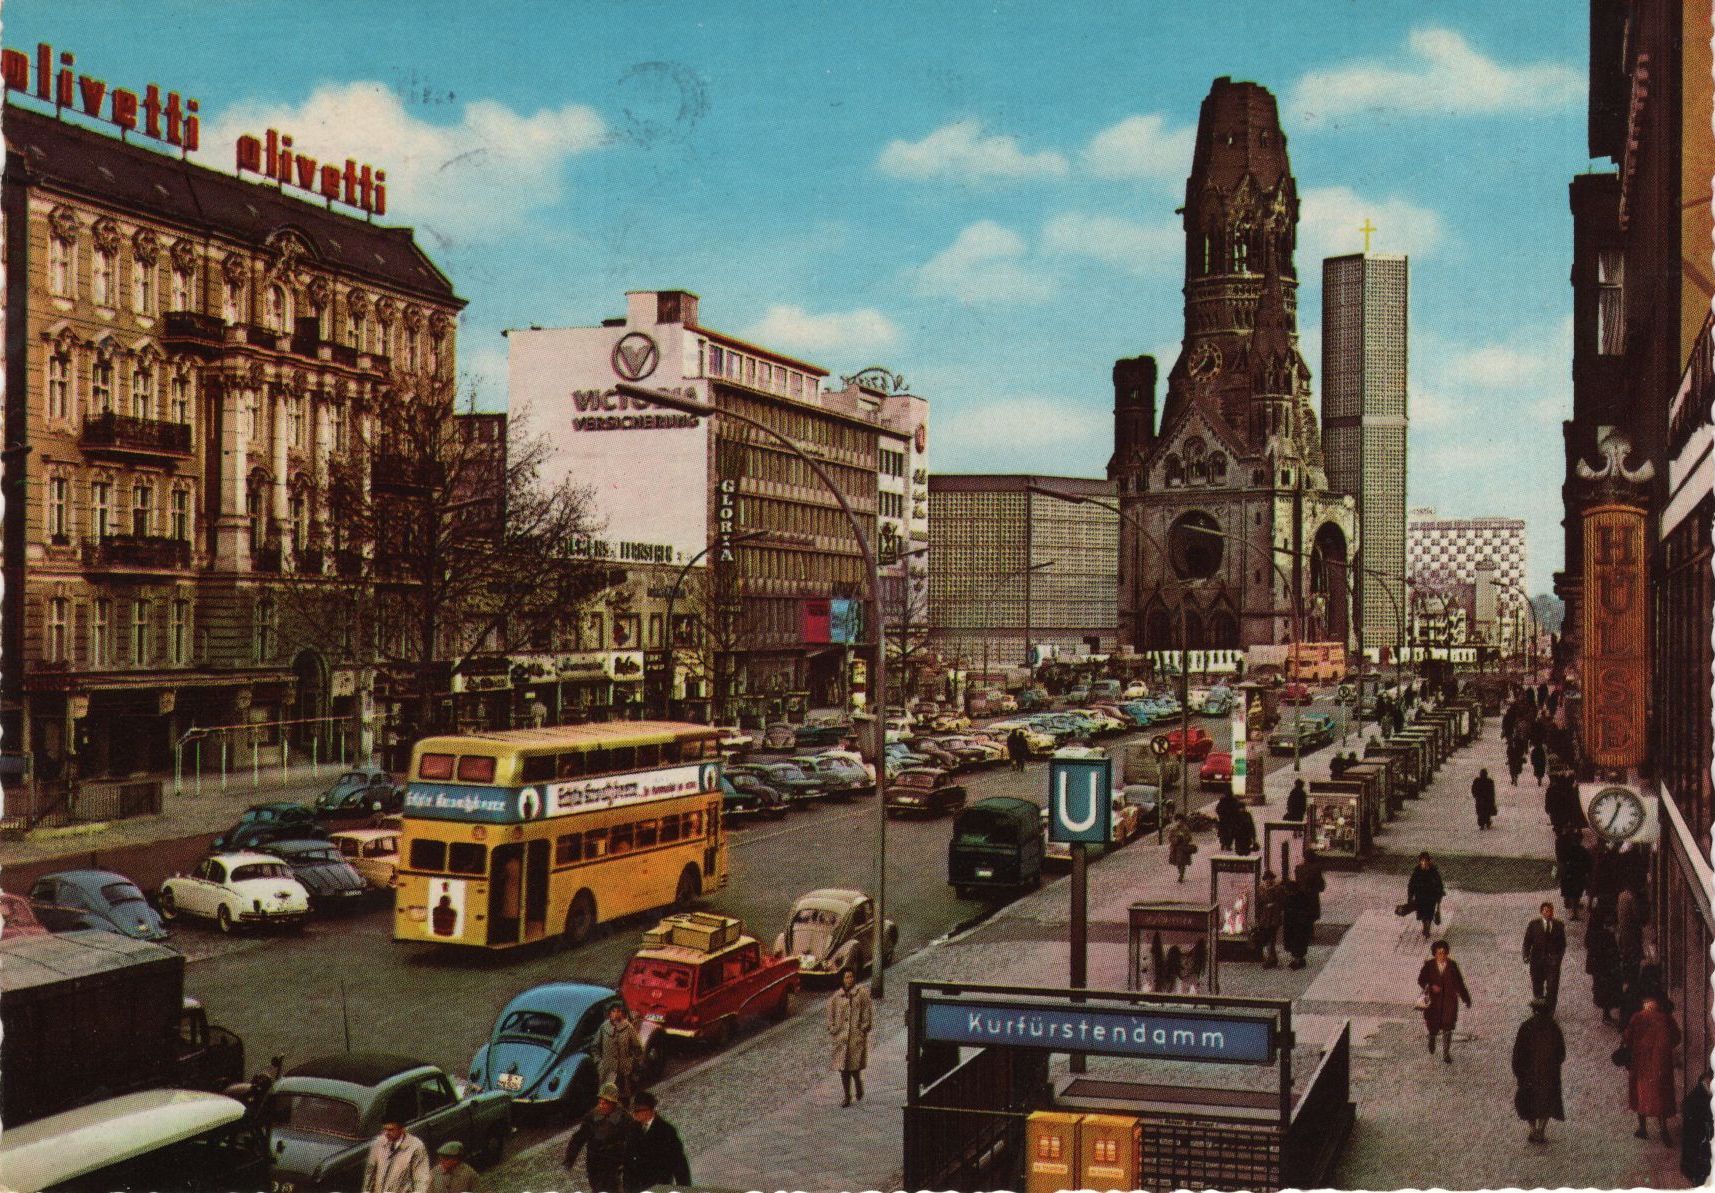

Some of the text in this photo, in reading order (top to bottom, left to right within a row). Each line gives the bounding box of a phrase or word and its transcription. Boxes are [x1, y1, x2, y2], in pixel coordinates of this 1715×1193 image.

[2, 43, 199, 151] olivetti
[237, 128, 385, 215] olivetti
[572, 414, 700, 431] VERSICHERUNG
[720, 479, 735, 561] GLORIA
[1059, 771, 1097, 832] U
[968, 1013, 1225, 1049] Kurfürstendamm
